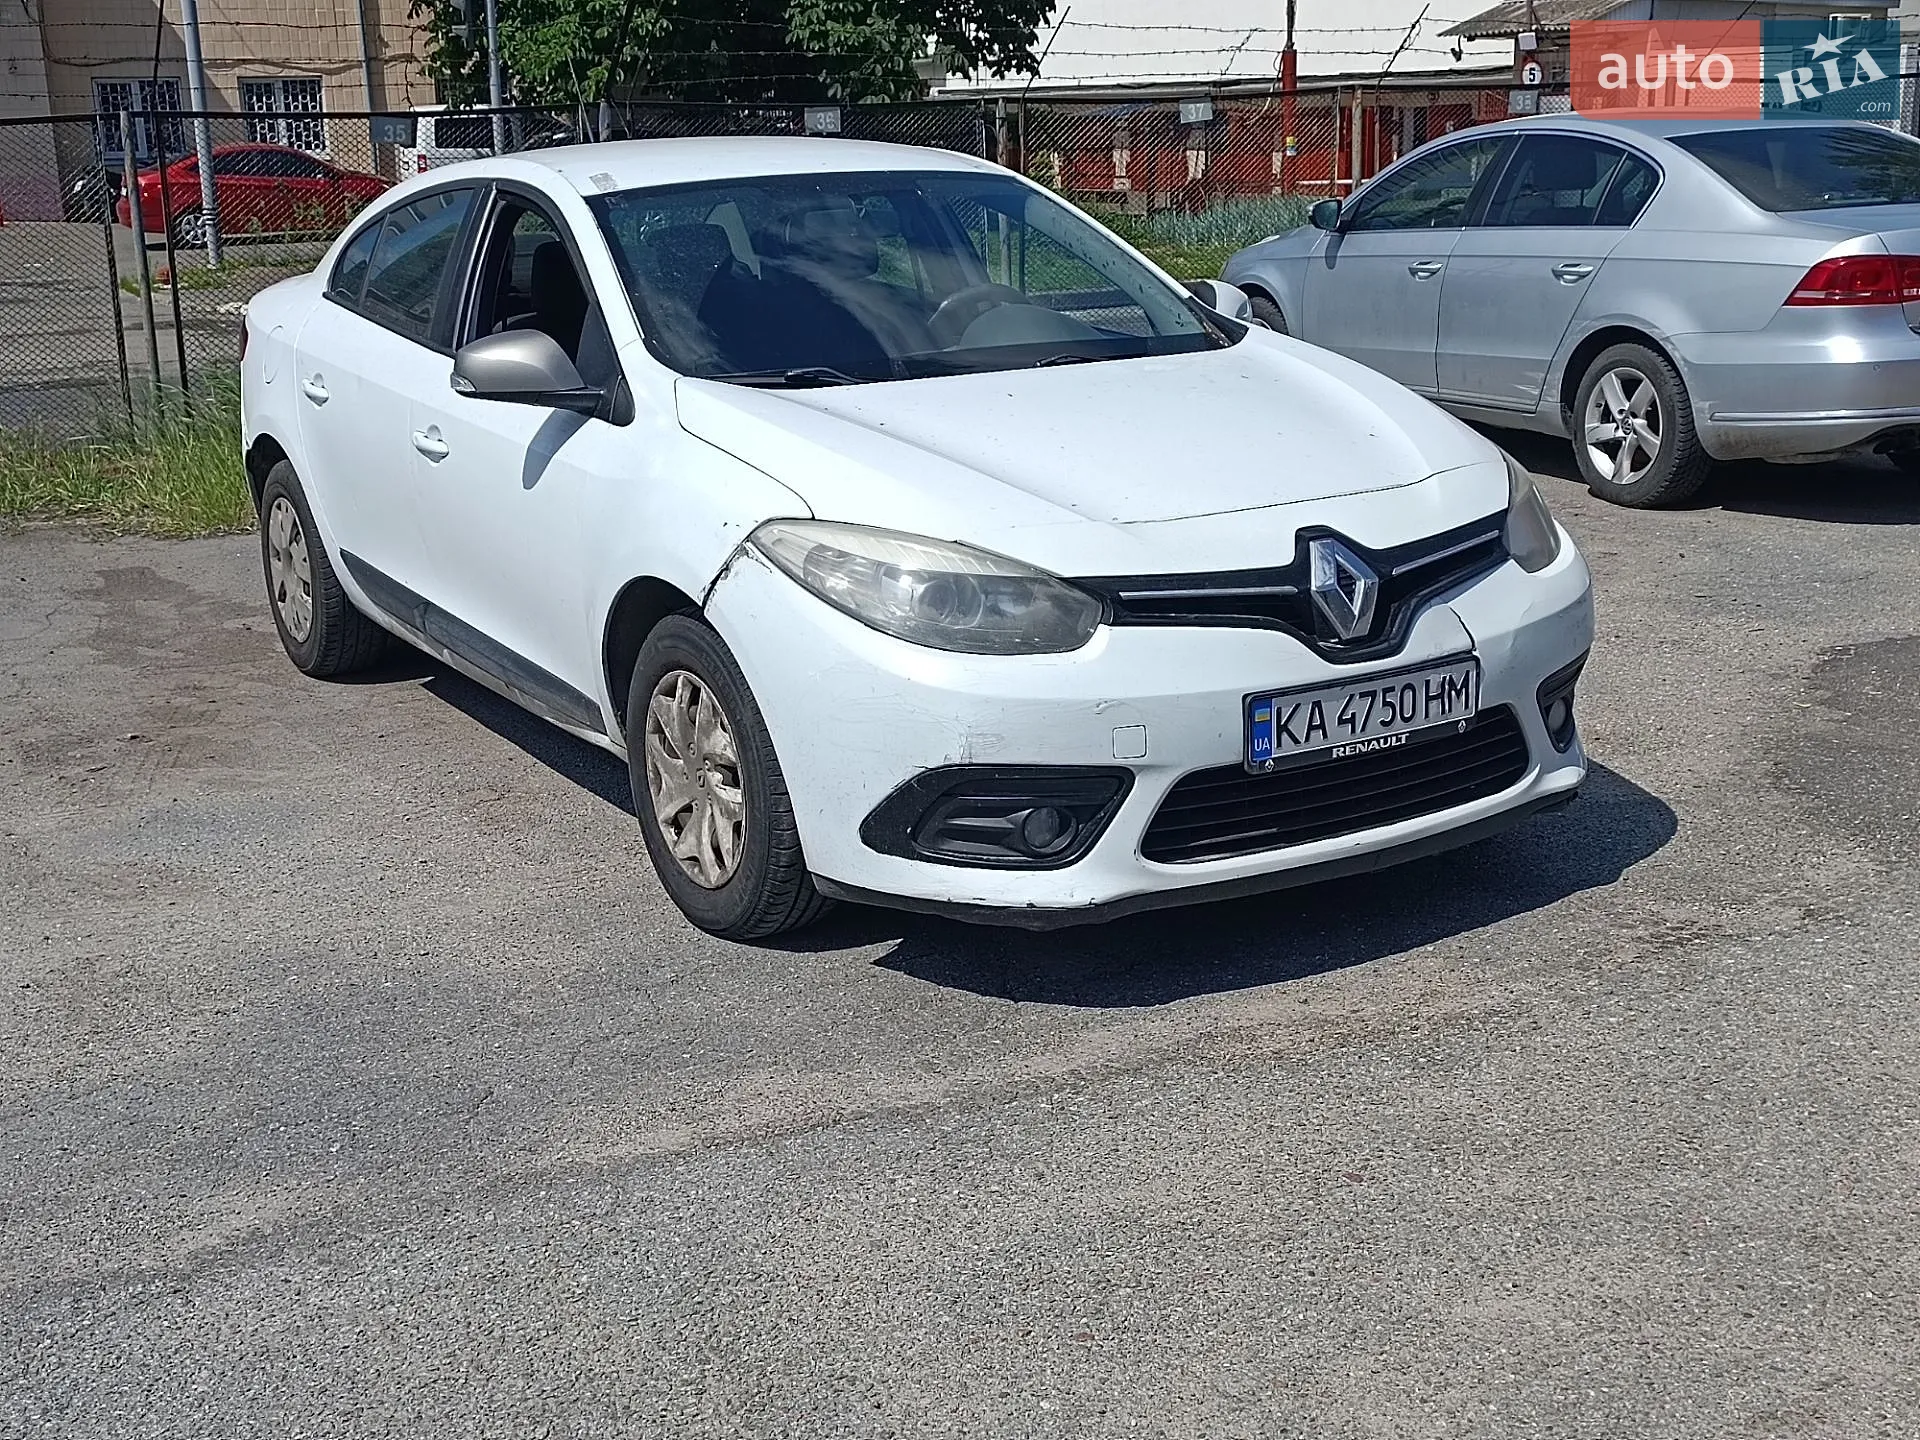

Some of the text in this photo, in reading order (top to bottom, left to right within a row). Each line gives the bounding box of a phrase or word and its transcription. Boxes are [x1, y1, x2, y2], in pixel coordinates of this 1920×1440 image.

[1528, 67, 1536, 82] 5
[1188, 103, 1204, 119] 37
[383, 124, 406, 142] 35
[1275, 669, 1472, 748] KA 4750 HM
[1254, 737, 1271, 751] UA
[1331, 733, 1410, 759] RENAULT
